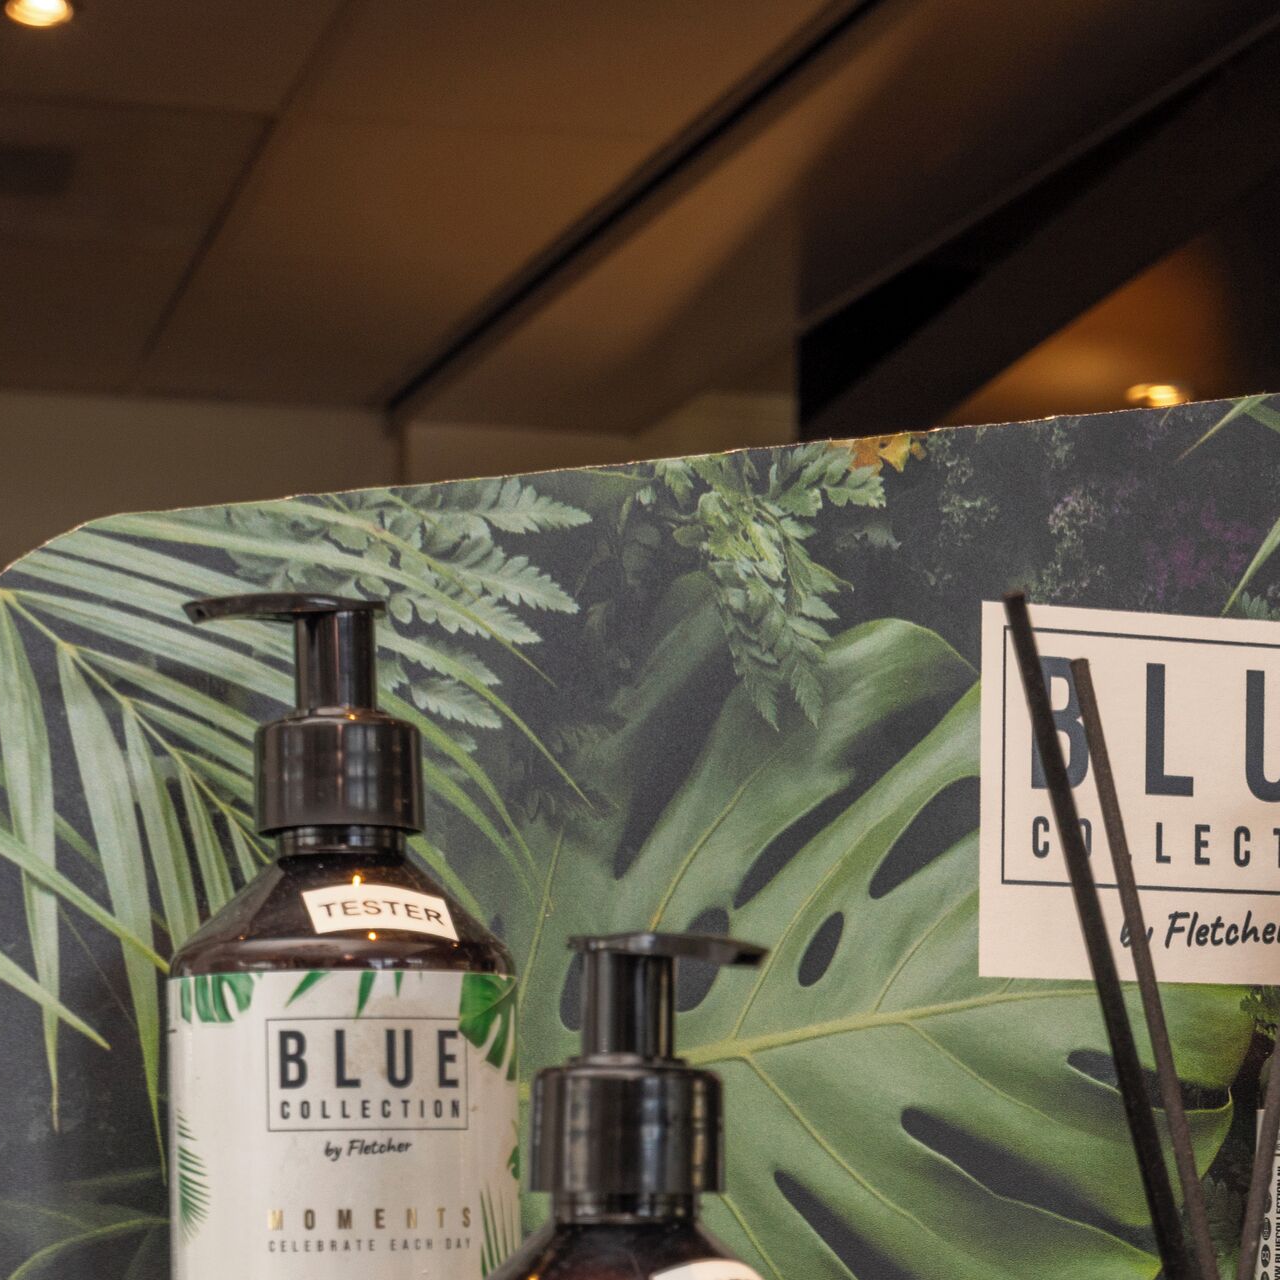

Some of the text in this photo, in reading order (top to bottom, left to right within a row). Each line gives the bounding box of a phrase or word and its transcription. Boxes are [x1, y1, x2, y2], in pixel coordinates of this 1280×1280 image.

[320, 900, 446, 926] TESTER
[279, 1029, 460, 1089] BLUE
[280, 1098, 460, 1120] COLLECTION
[324, 1138, 412, 1161] by Fletcher
[268, 1207, 472, 1231] MOMENTS
[269, 1236, 472, 1253] CELEBRATE EACH DAY
